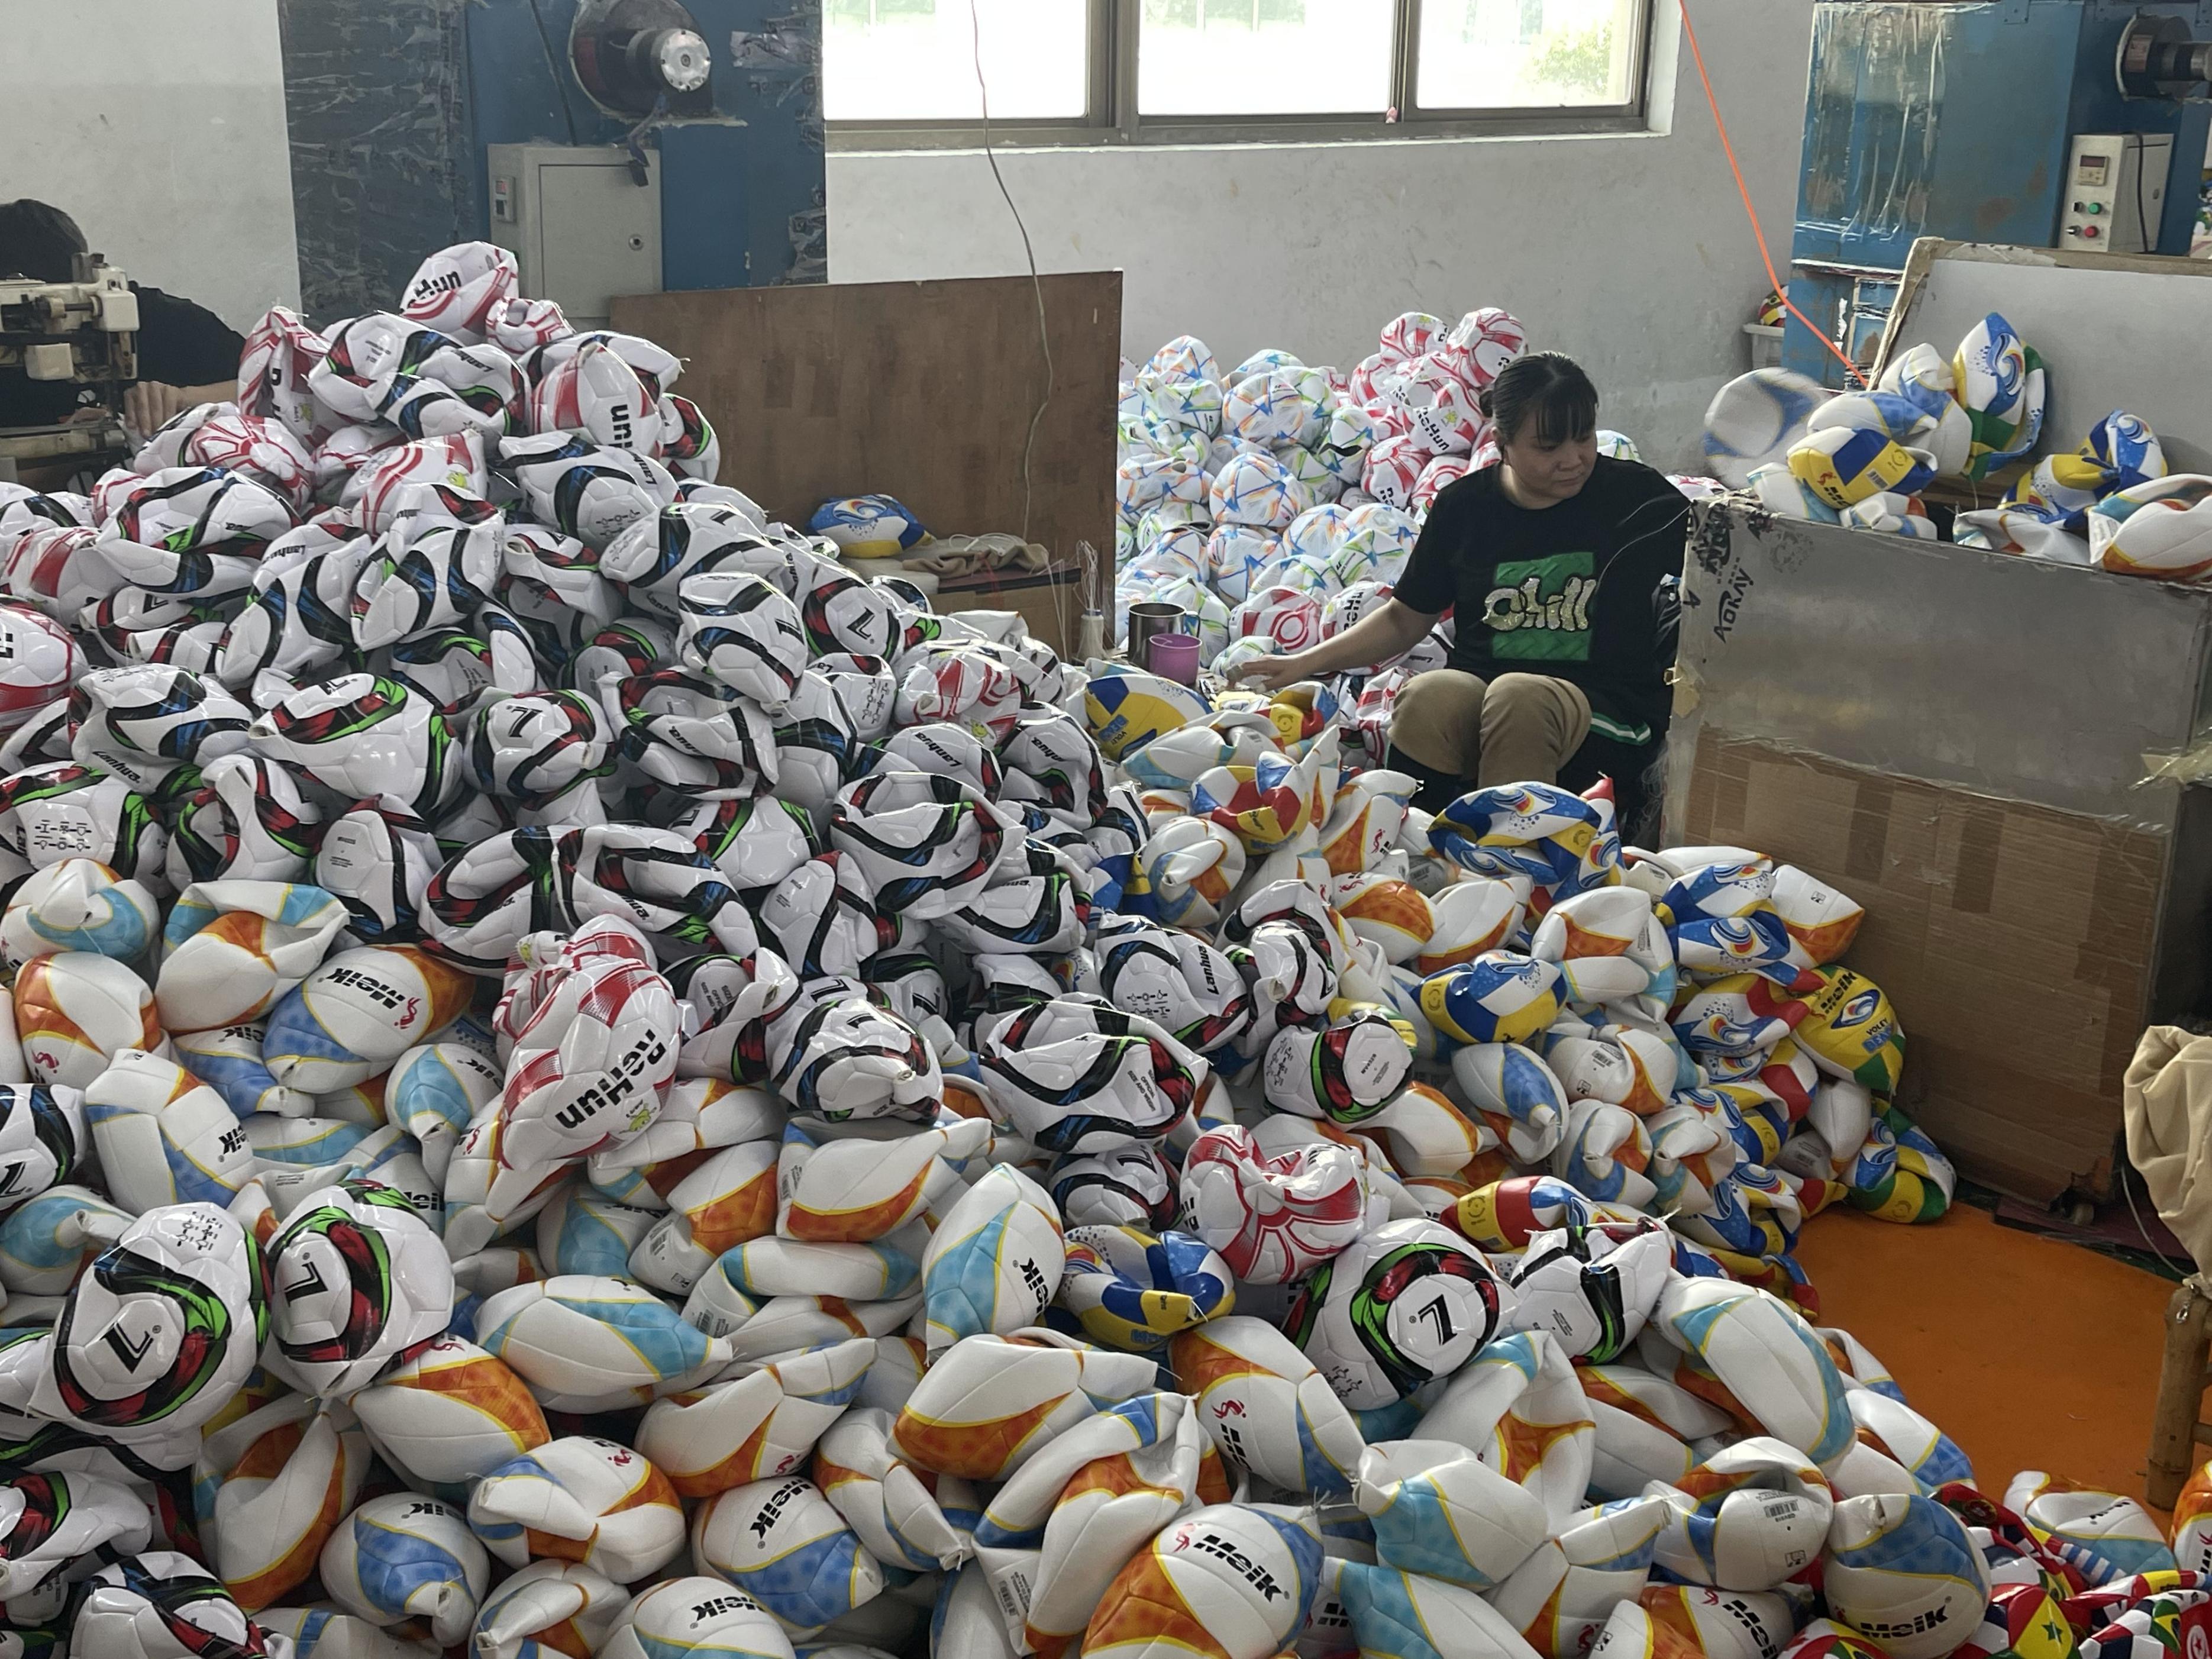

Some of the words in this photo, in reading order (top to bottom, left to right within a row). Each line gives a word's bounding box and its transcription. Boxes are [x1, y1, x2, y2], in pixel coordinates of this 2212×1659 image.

[92, 751, 140, 783] Lanhua
[915, 732, 963, 767] Lanhua
[327, 967, 406, 1009] Meik
[1198, 945, 1219, 995] Lanhua
[750, 1479, 812, 1538] Meik
[1193, 1534, 1283, 1602] Meik
[1860, 1605, 1948, 1639] Meik
